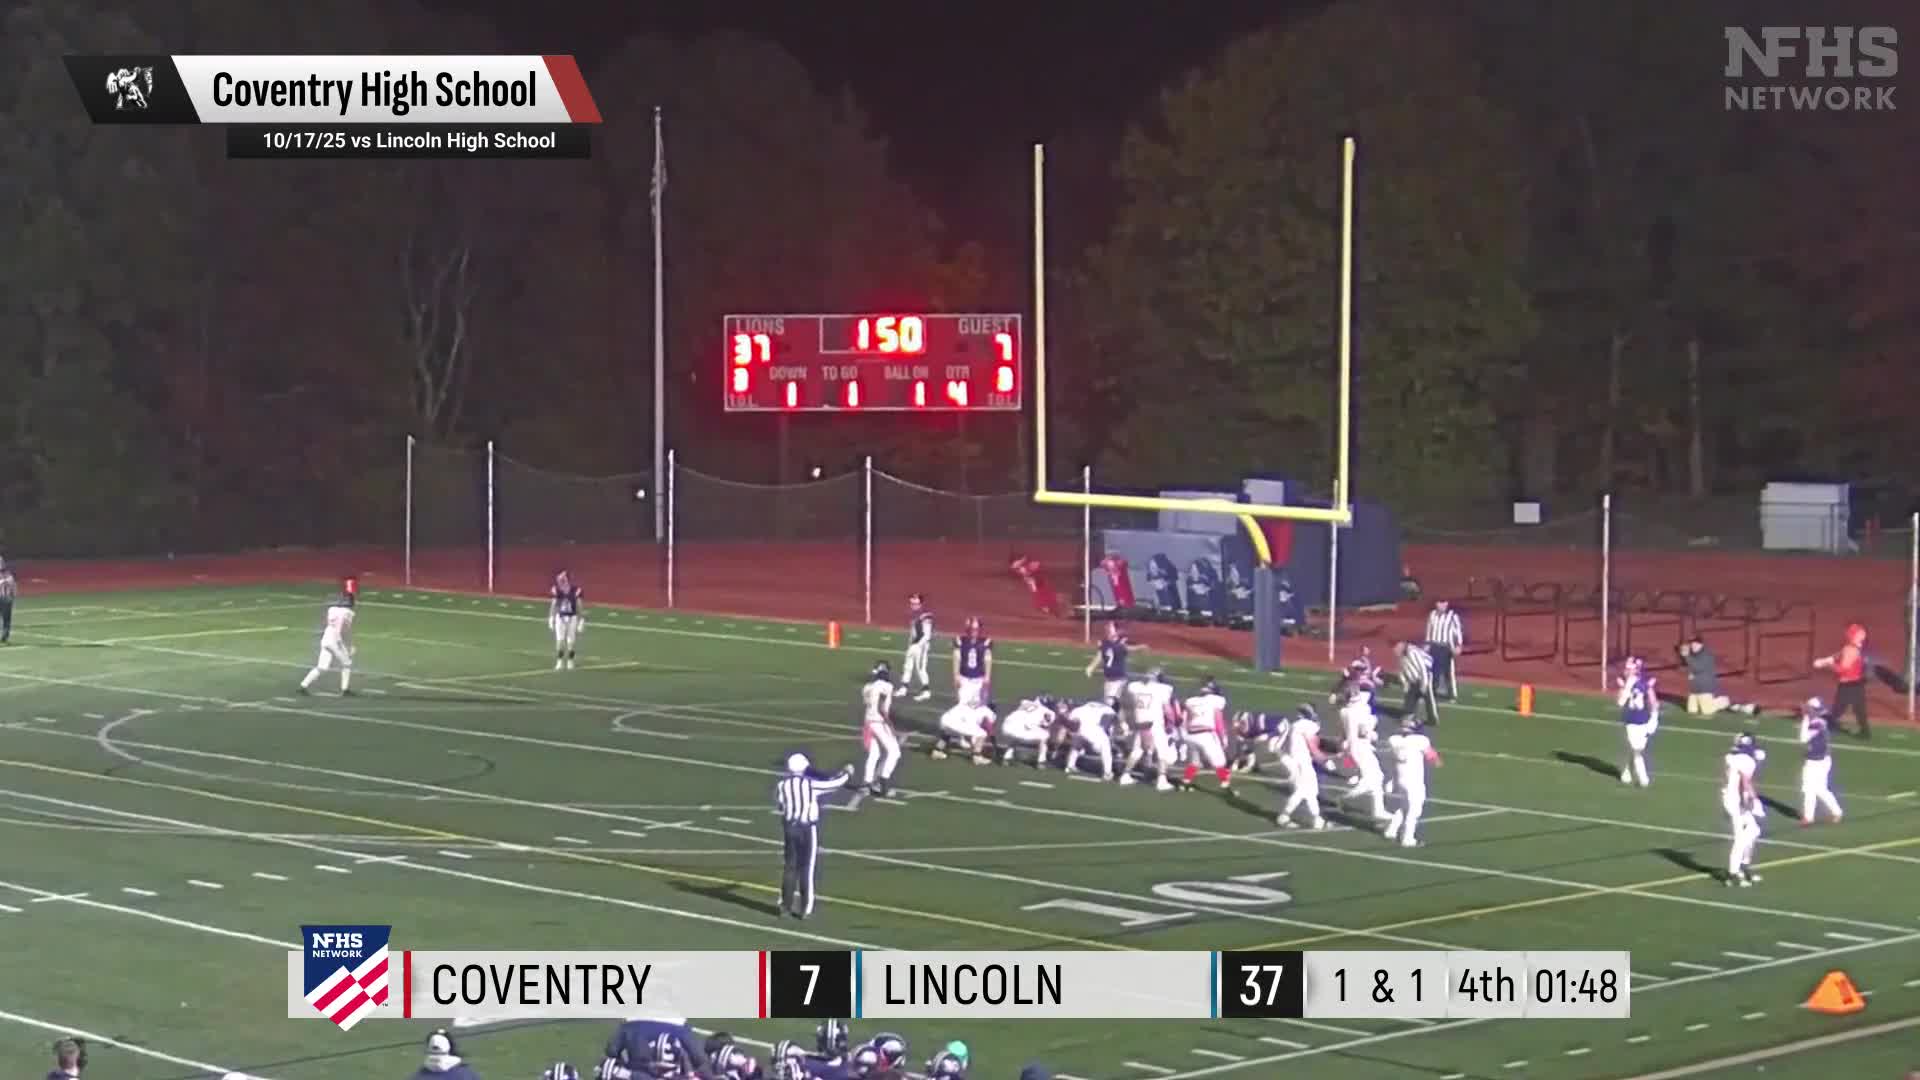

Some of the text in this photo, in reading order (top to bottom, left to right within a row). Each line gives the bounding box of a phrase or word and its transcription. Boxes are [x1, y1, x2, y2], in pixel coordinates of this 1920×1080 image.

[736, 318, 785, 335] LIONS
[958, 318, 1012, 335] GUEST
[733, 334, 771, 365] 37
[995, 333, 1013, 361] 7
[769, 366, 808, 379] DOWN
[786, 381, 798, 407] 1
[847, 381, 859, 407] 1
[914, 381, 926, 407] 1
[946, 381, 969, 406] 4
[1020, 881, 1293, 928] 10
